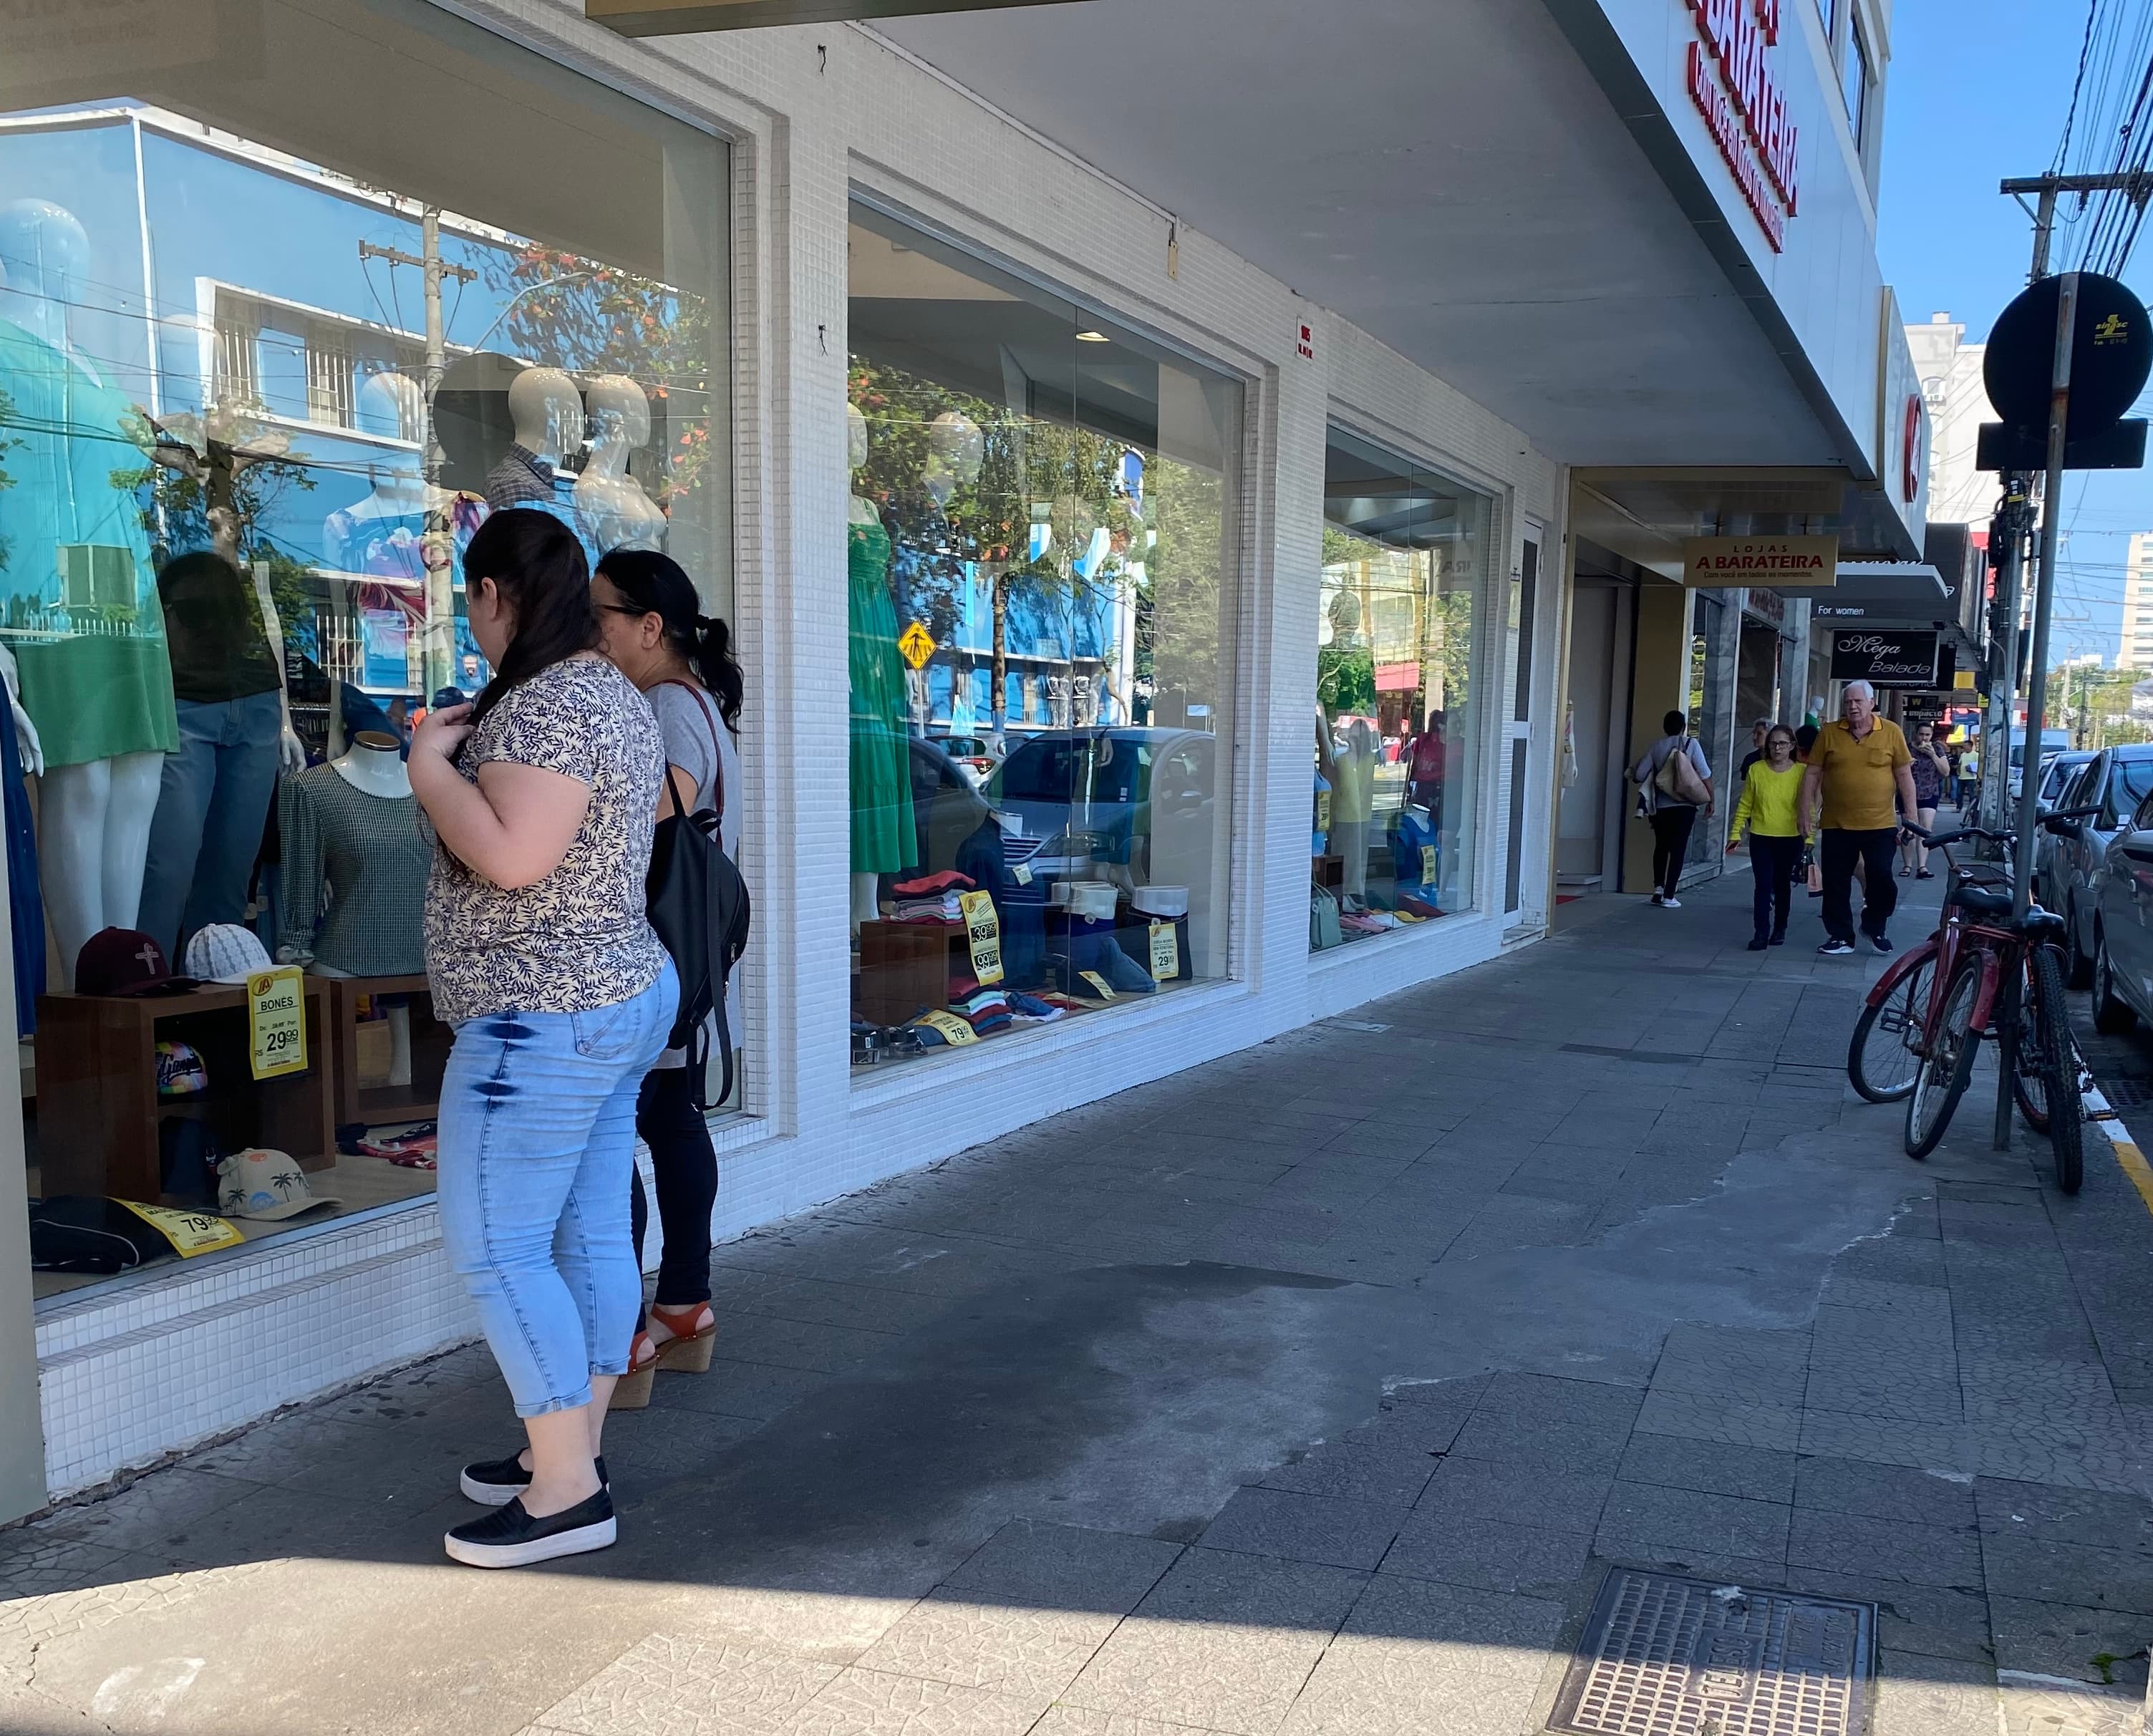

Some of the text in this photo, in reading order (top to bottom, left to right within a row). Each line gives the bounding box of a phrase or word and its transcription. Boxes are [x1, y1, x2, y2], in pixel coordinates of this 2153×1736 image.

[1733, 545, 1789, 553] LOJAS
[1695, 556, 1711, 569] A
[1715, 555, 1824, 570] BARATEIRA
[1818, 605, 1864, 616] For women
[1837, 634, 1902, 660] Mega
[1867, 661, 1932, 674] Balada
